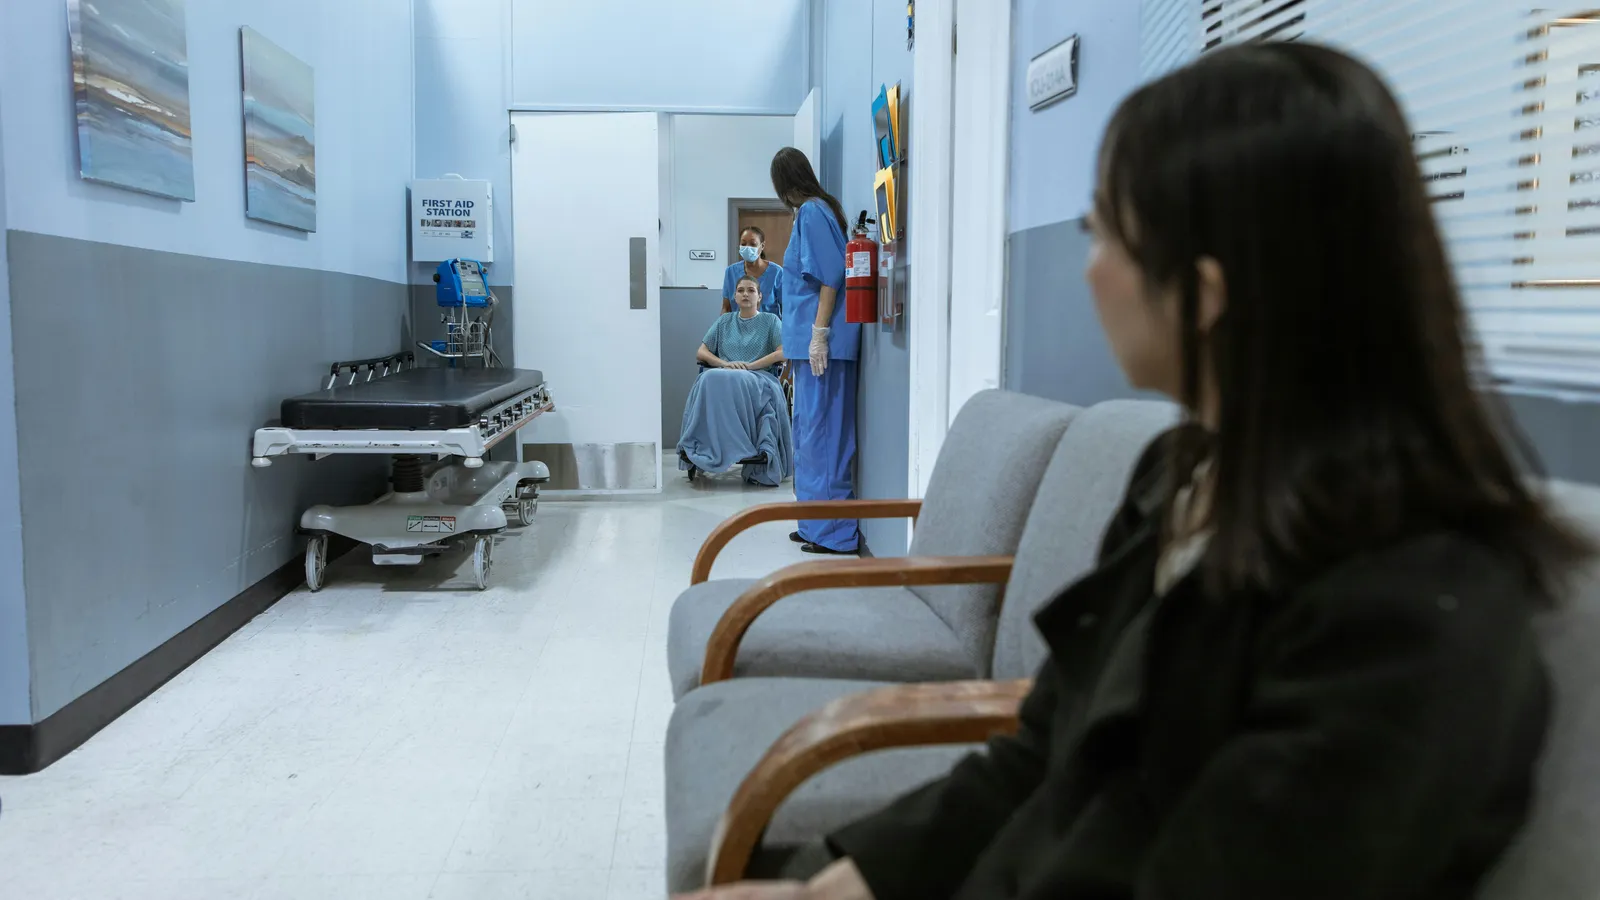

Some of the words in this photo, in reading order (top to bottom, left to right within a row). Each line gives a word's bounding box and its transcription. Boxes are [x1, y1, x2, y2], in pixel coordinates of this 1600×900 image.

[422, 199, 452, 208] FIRST
[454, 200, 474, 208] AID
[426, 208, 471, 217] STATION
